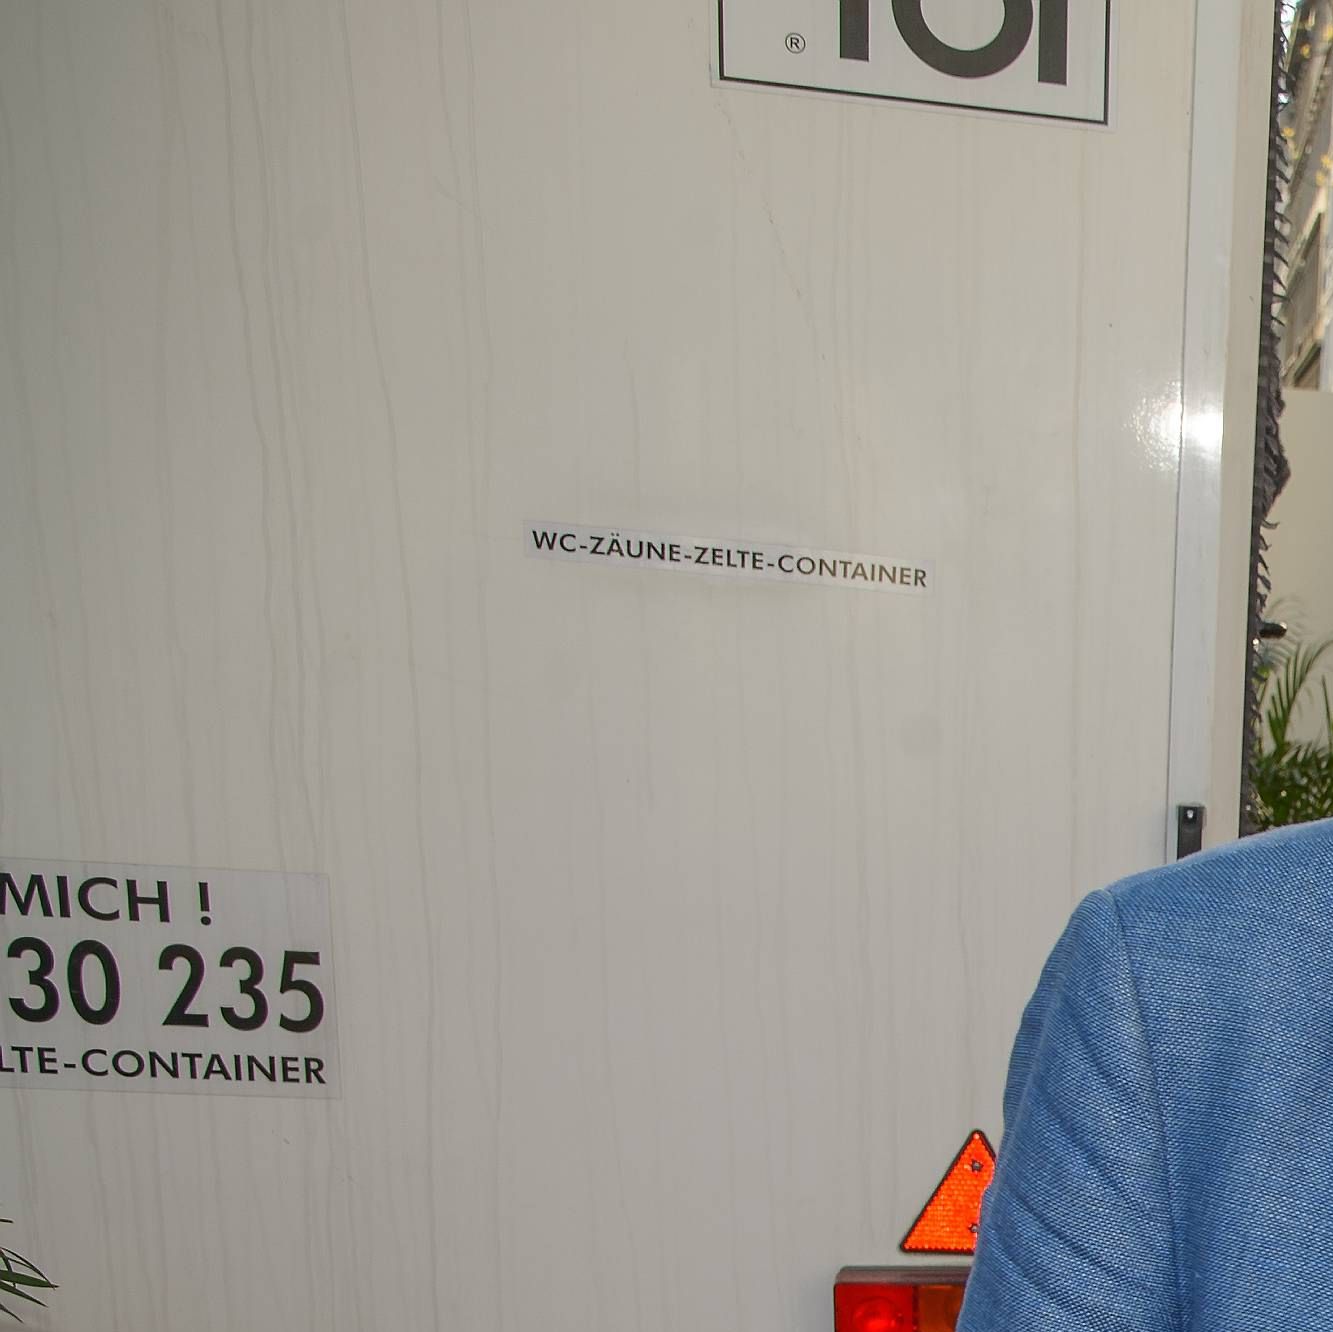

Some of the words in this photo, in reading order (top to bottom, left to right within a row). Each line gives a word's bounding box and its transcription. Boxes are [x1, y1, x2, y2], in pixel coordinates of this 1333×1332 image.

[531, 530, 926, 588] WC-ZÄUNE-ZELTE-CONTAINER
[0, 872, 170, 923] MICH
[7, 936, 121, 1026] 30
[158, 943, 324, 1033] 235
